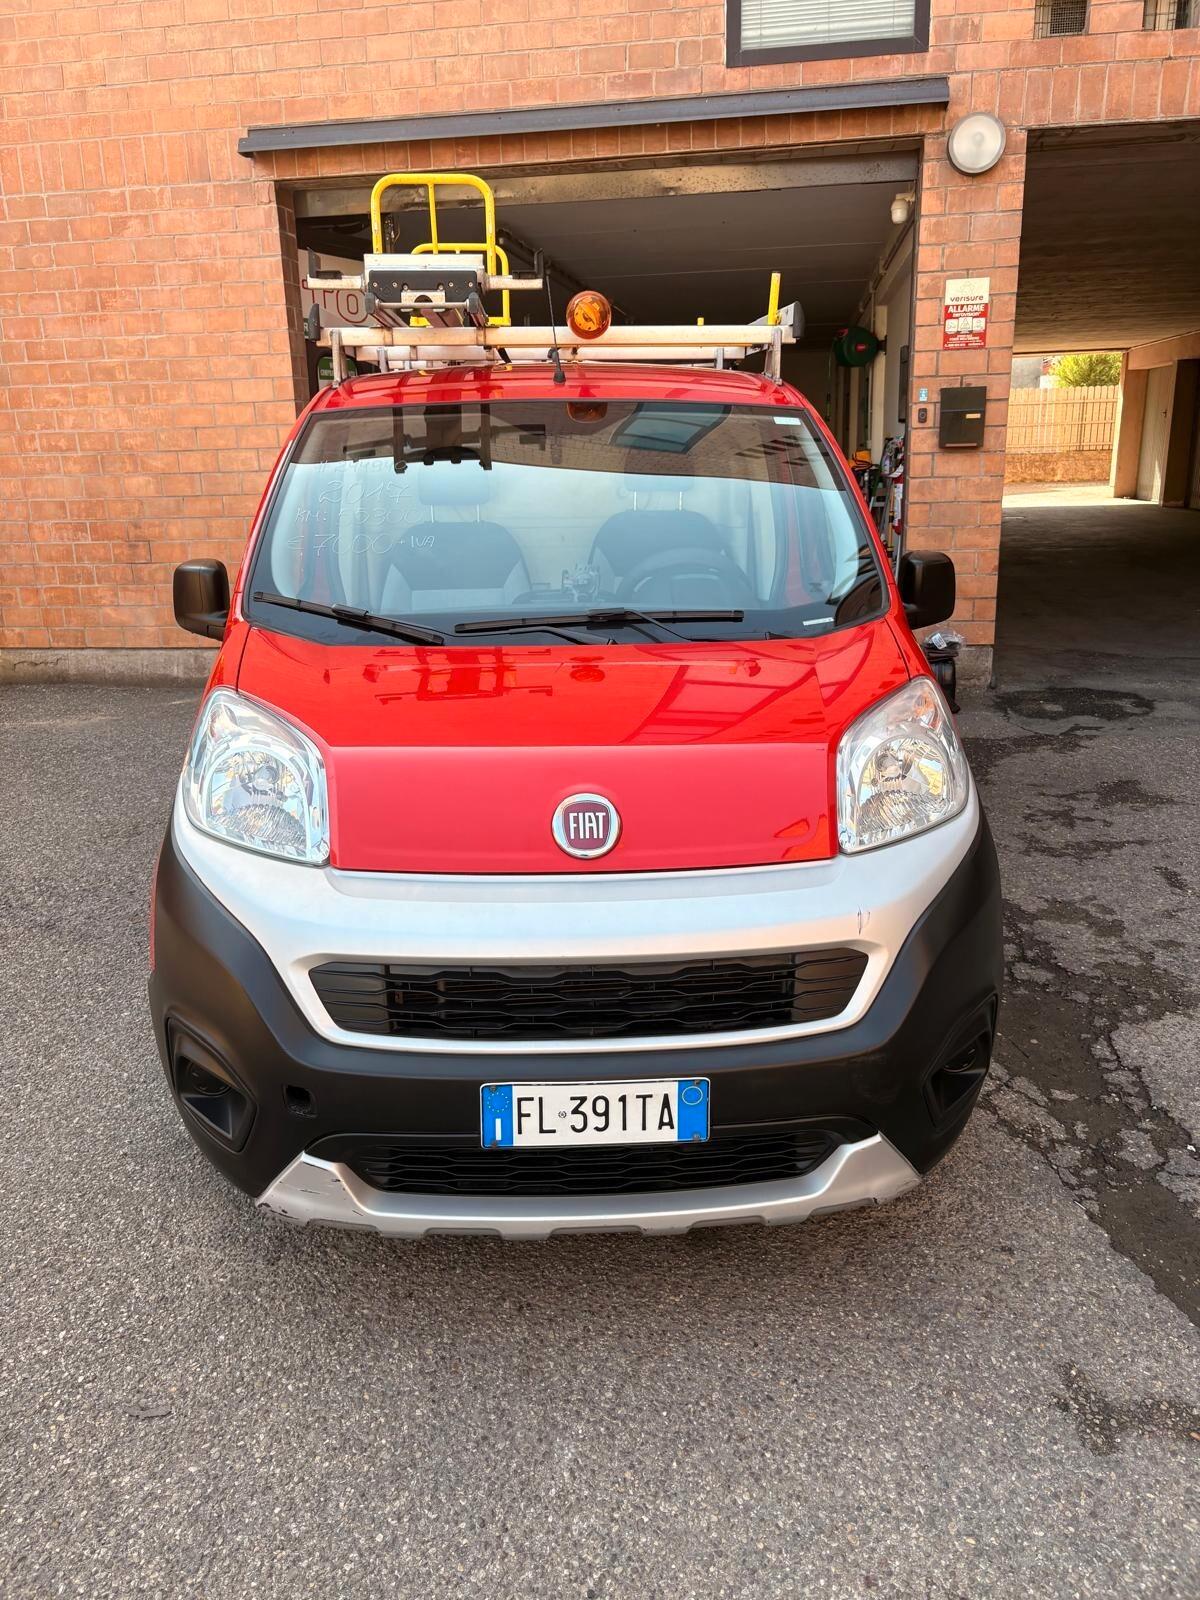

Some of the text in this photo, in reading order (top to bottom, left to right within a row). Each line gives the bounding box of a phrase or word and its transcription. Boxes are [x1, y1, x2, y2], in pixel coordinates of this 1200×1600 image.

[948, 304, 985, 313] ALLARME
[568, 812, 607, 840] FIAT
[516, 1093, 675, 1135] FL 391TA
